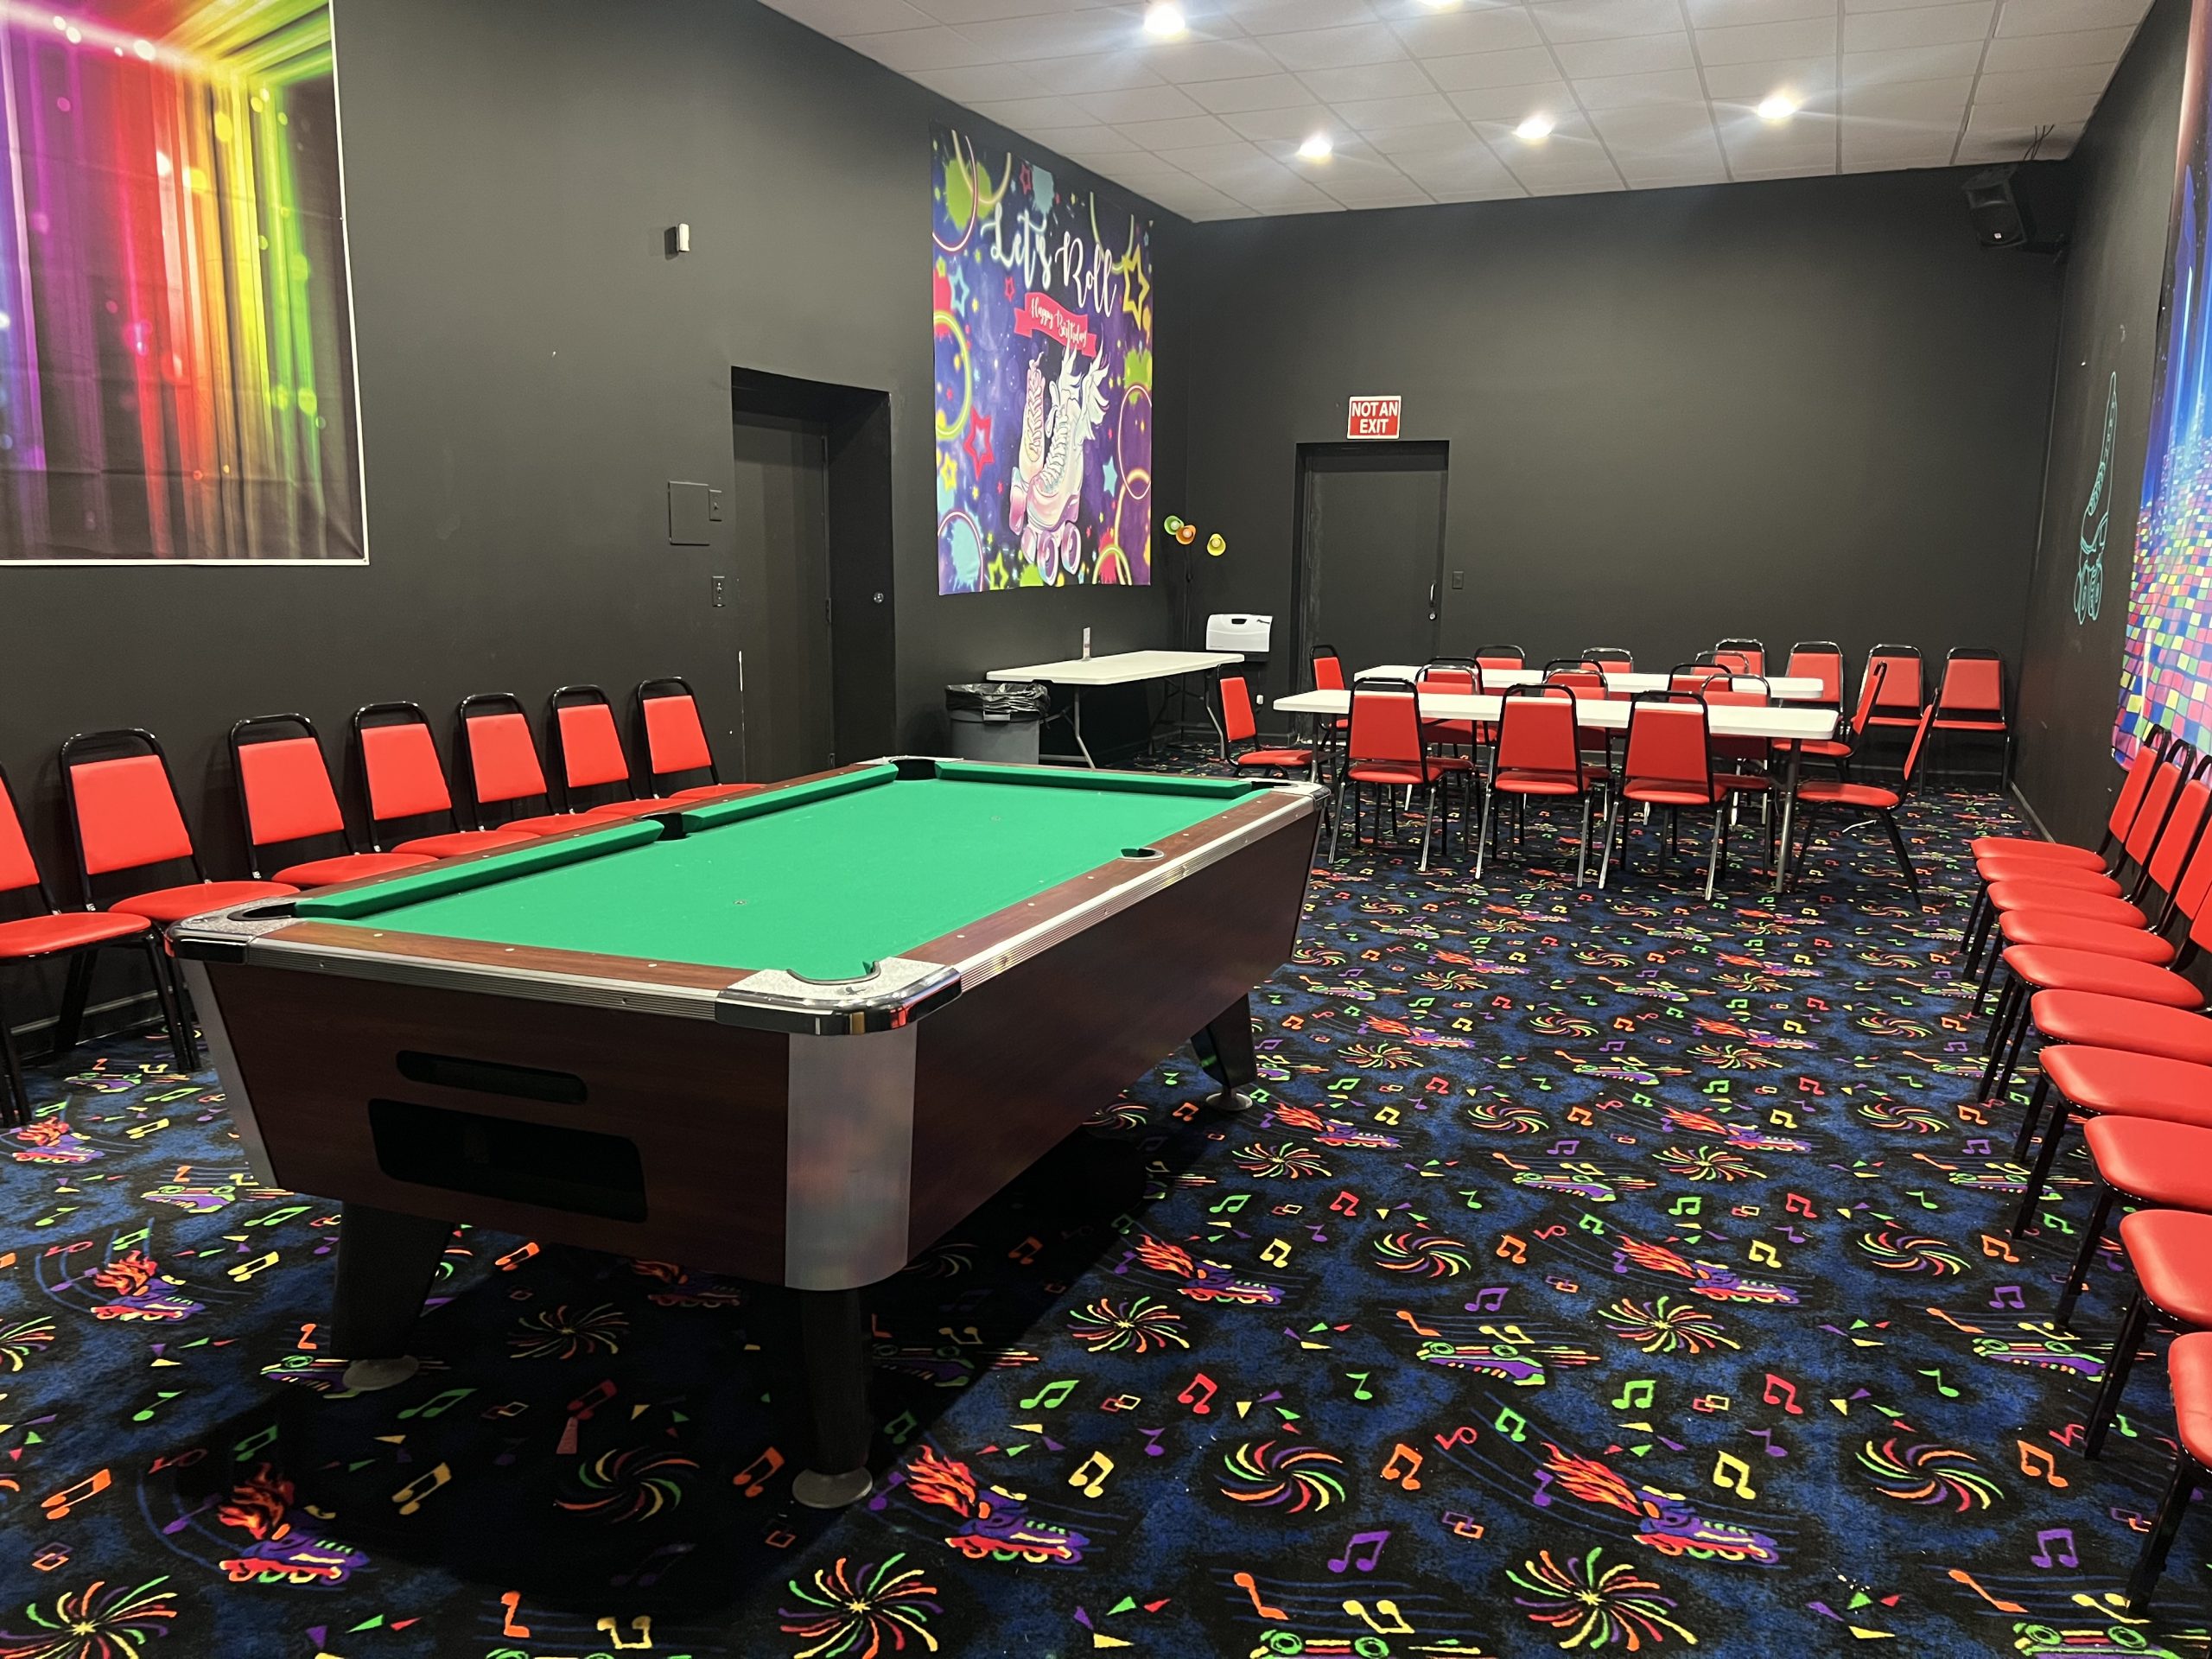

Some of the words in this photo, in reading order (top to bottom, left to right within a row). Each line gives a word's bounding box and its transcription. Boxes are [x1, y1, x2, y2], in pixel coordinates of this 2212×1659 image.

[1054, 231, 1116, 317] Roll
[1031, 296, 1053, 330] Happy
[1054, 309, 1087, 347] Birthday
[1351, 402, 1379, 416] NOT
[1379, 401, 1398, 416] AN
[1359, 418, 1389, 434] EXIT
